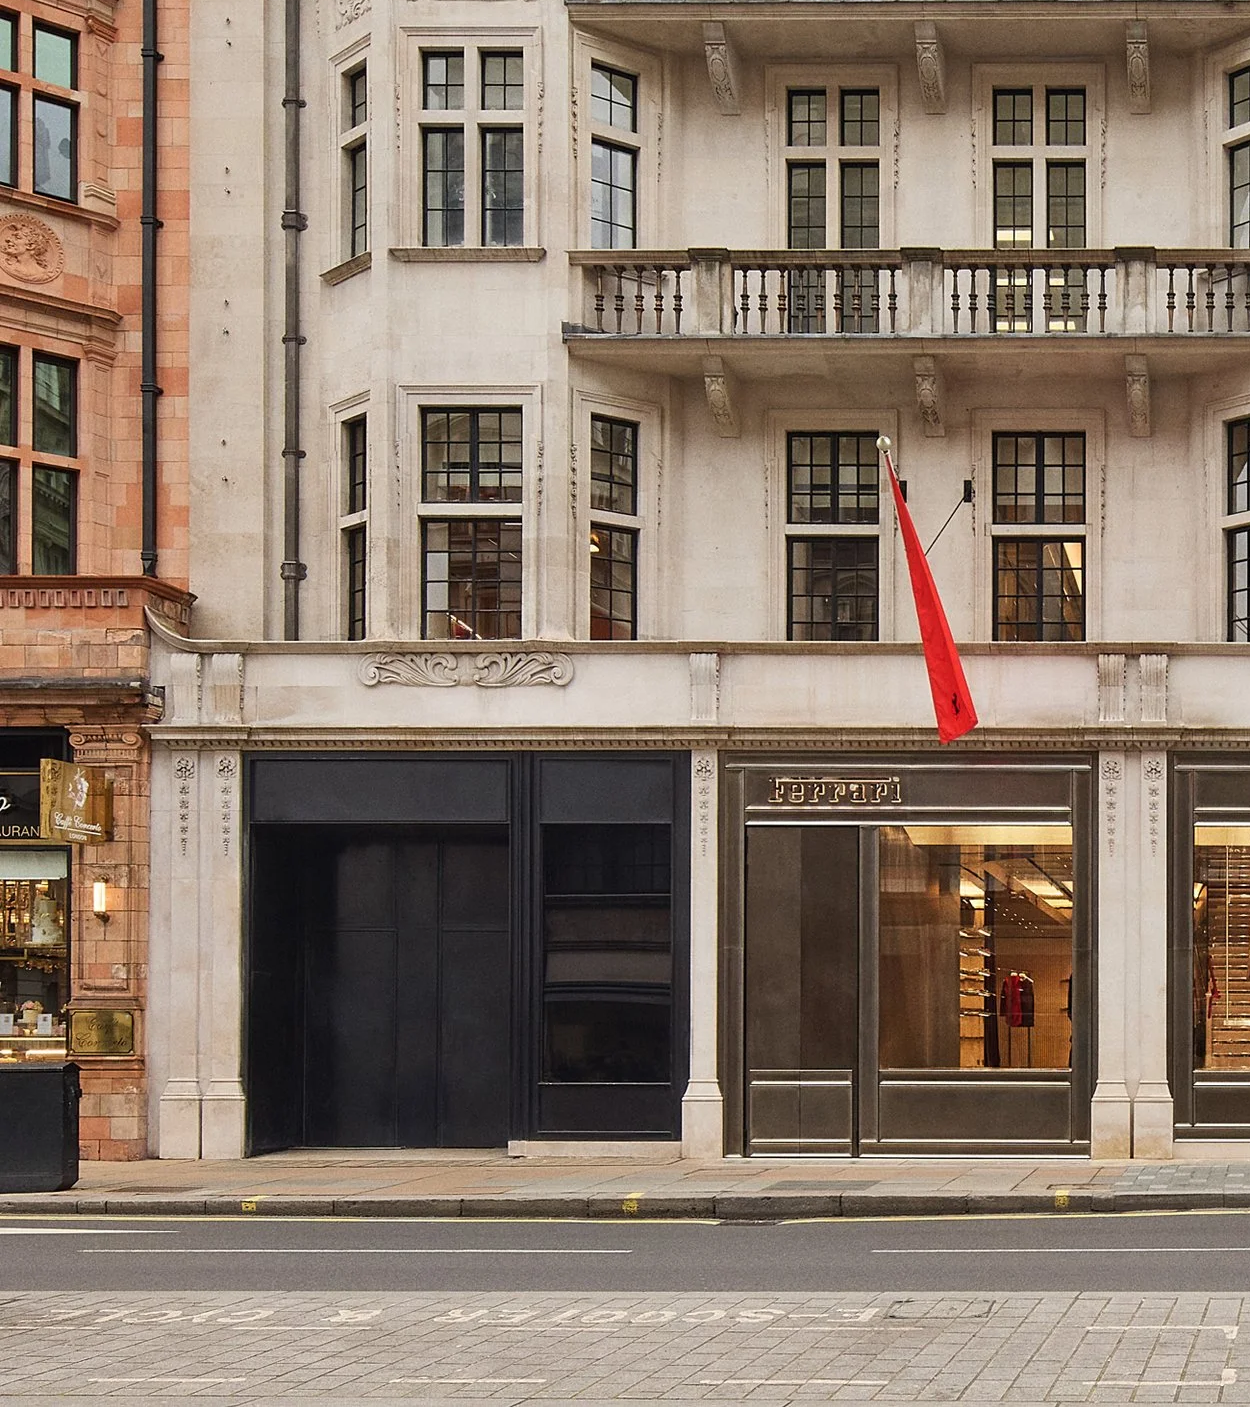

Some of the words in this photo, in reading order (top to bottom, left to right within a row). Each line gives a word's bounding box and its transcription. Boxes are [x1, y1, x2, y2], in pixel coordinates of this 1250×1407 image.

[768, 777, 901, 803] Ferrari
[0, 825, 40, 837] URAN
[19, 1309, 275, 1324] CYCLE
